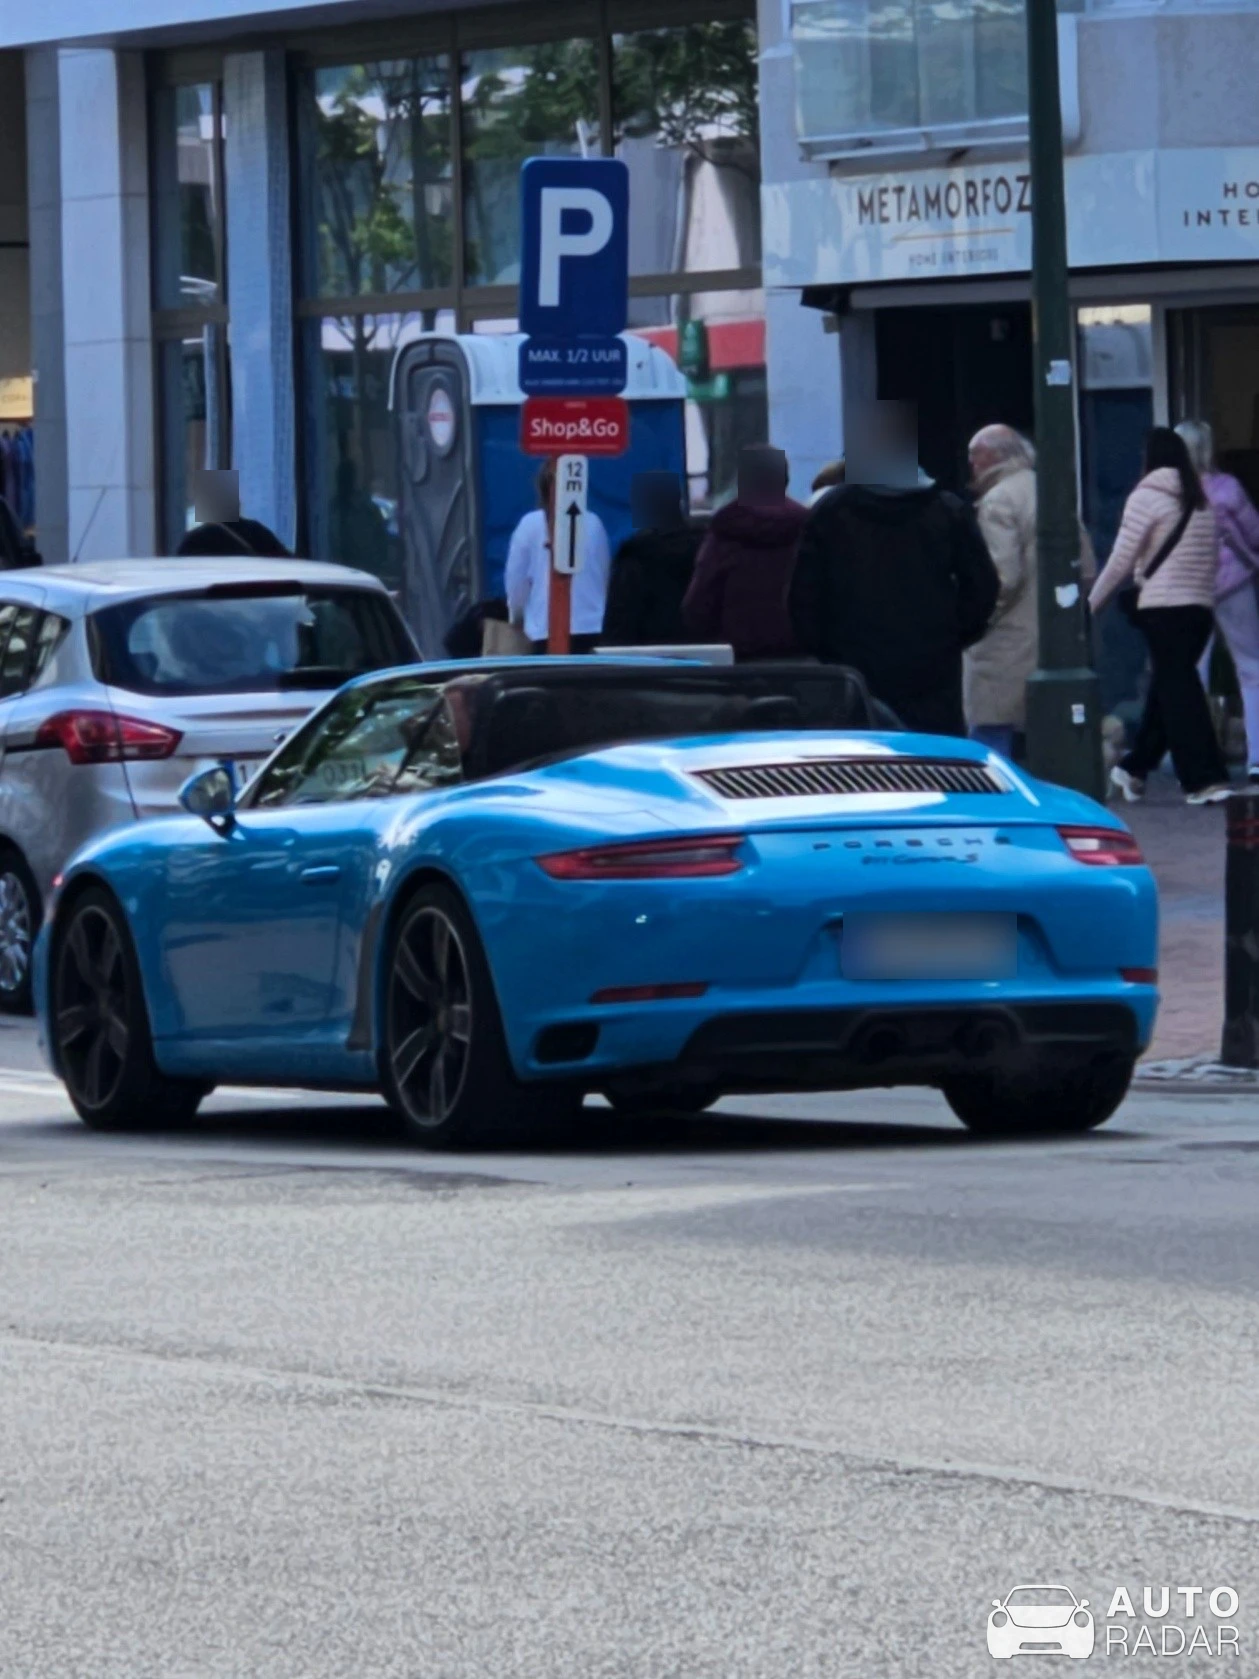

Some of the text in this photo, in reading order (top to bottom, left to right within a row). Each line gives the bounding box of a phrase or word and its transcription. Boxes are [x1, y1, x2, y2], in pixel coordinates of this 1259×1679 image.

[538, 187, 613, 307] P
[528, 348, 620, 363] MAX. 1/2 UUR
[530, 417, 619, 440] Shop&Go
[567, 461, 582, 477] 12
[566, 480, 582, 492] m
